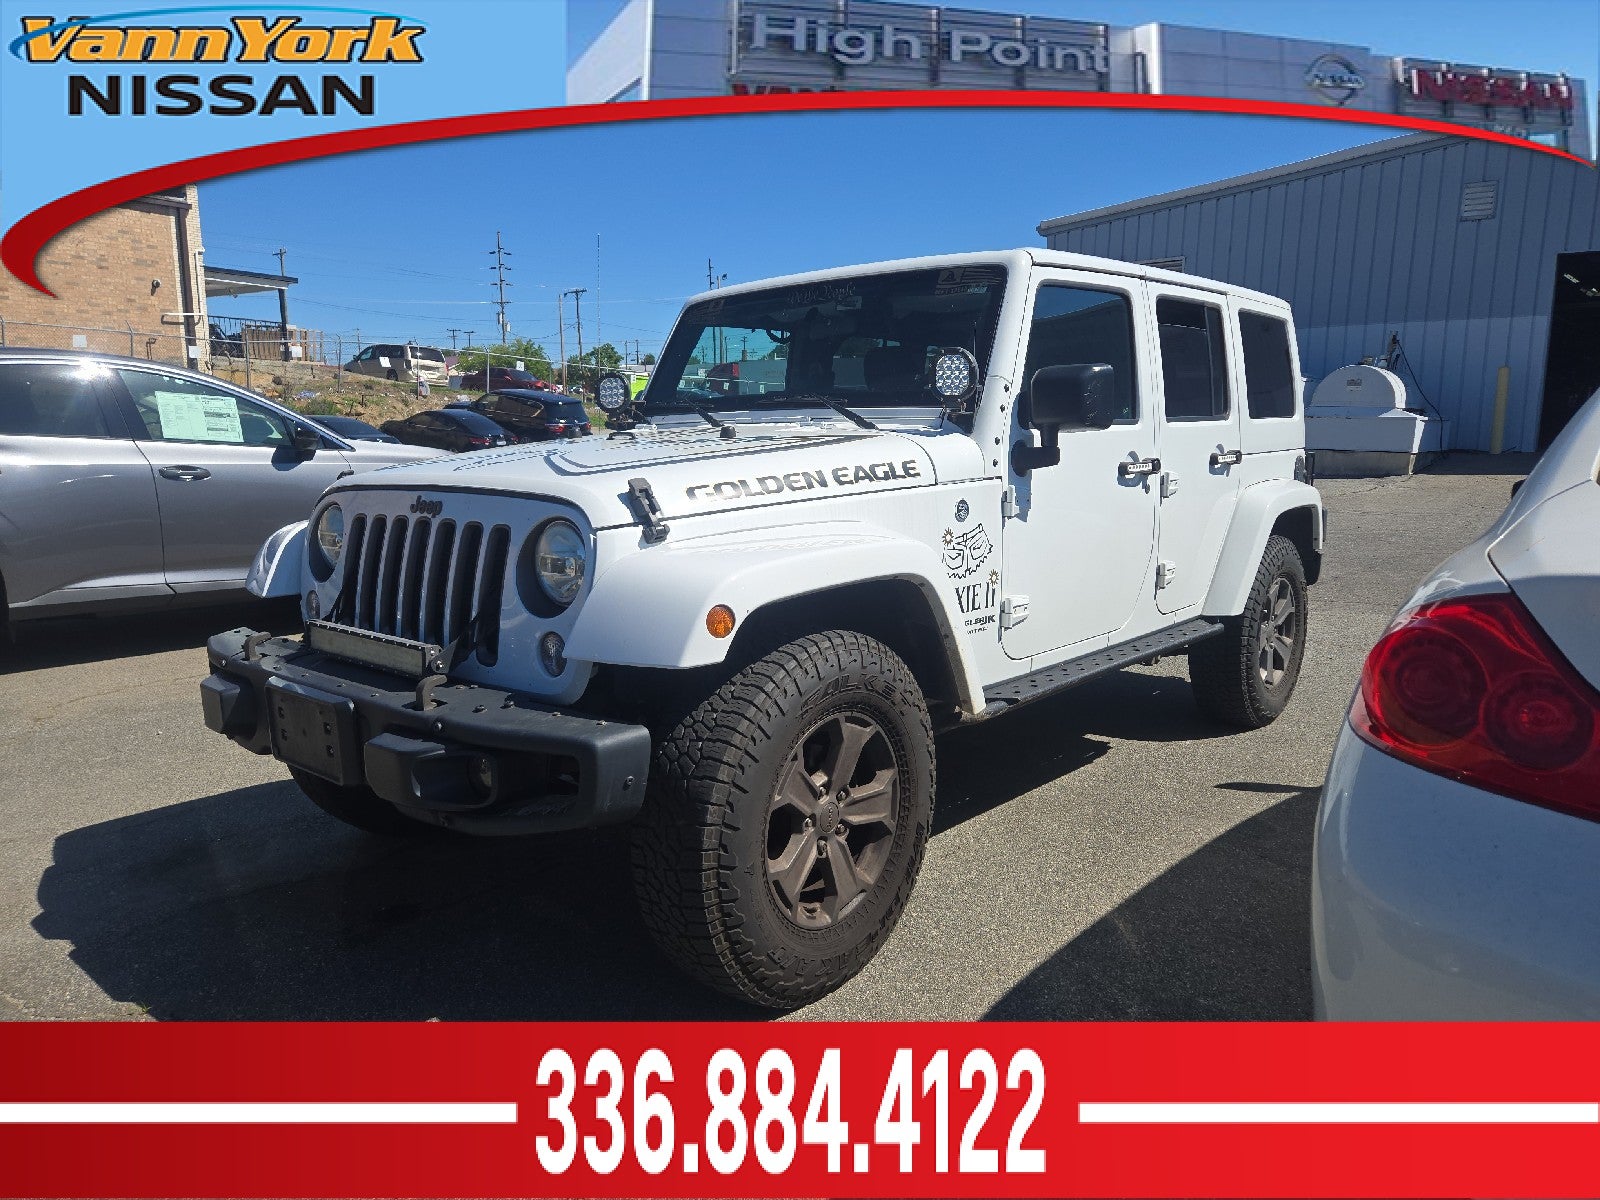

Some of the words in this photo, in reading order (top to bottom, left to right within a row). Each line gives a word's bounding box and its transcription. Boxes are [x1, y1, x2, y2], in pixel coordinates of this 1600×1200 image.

[751, 12, 922, 65] High
[949, 28, 1109, 73] Point
[685, 468, 829, 501] GOLDEN
[831, 458, 921, 486] EAGLE
[410, 495, 443, 518] Jeep
